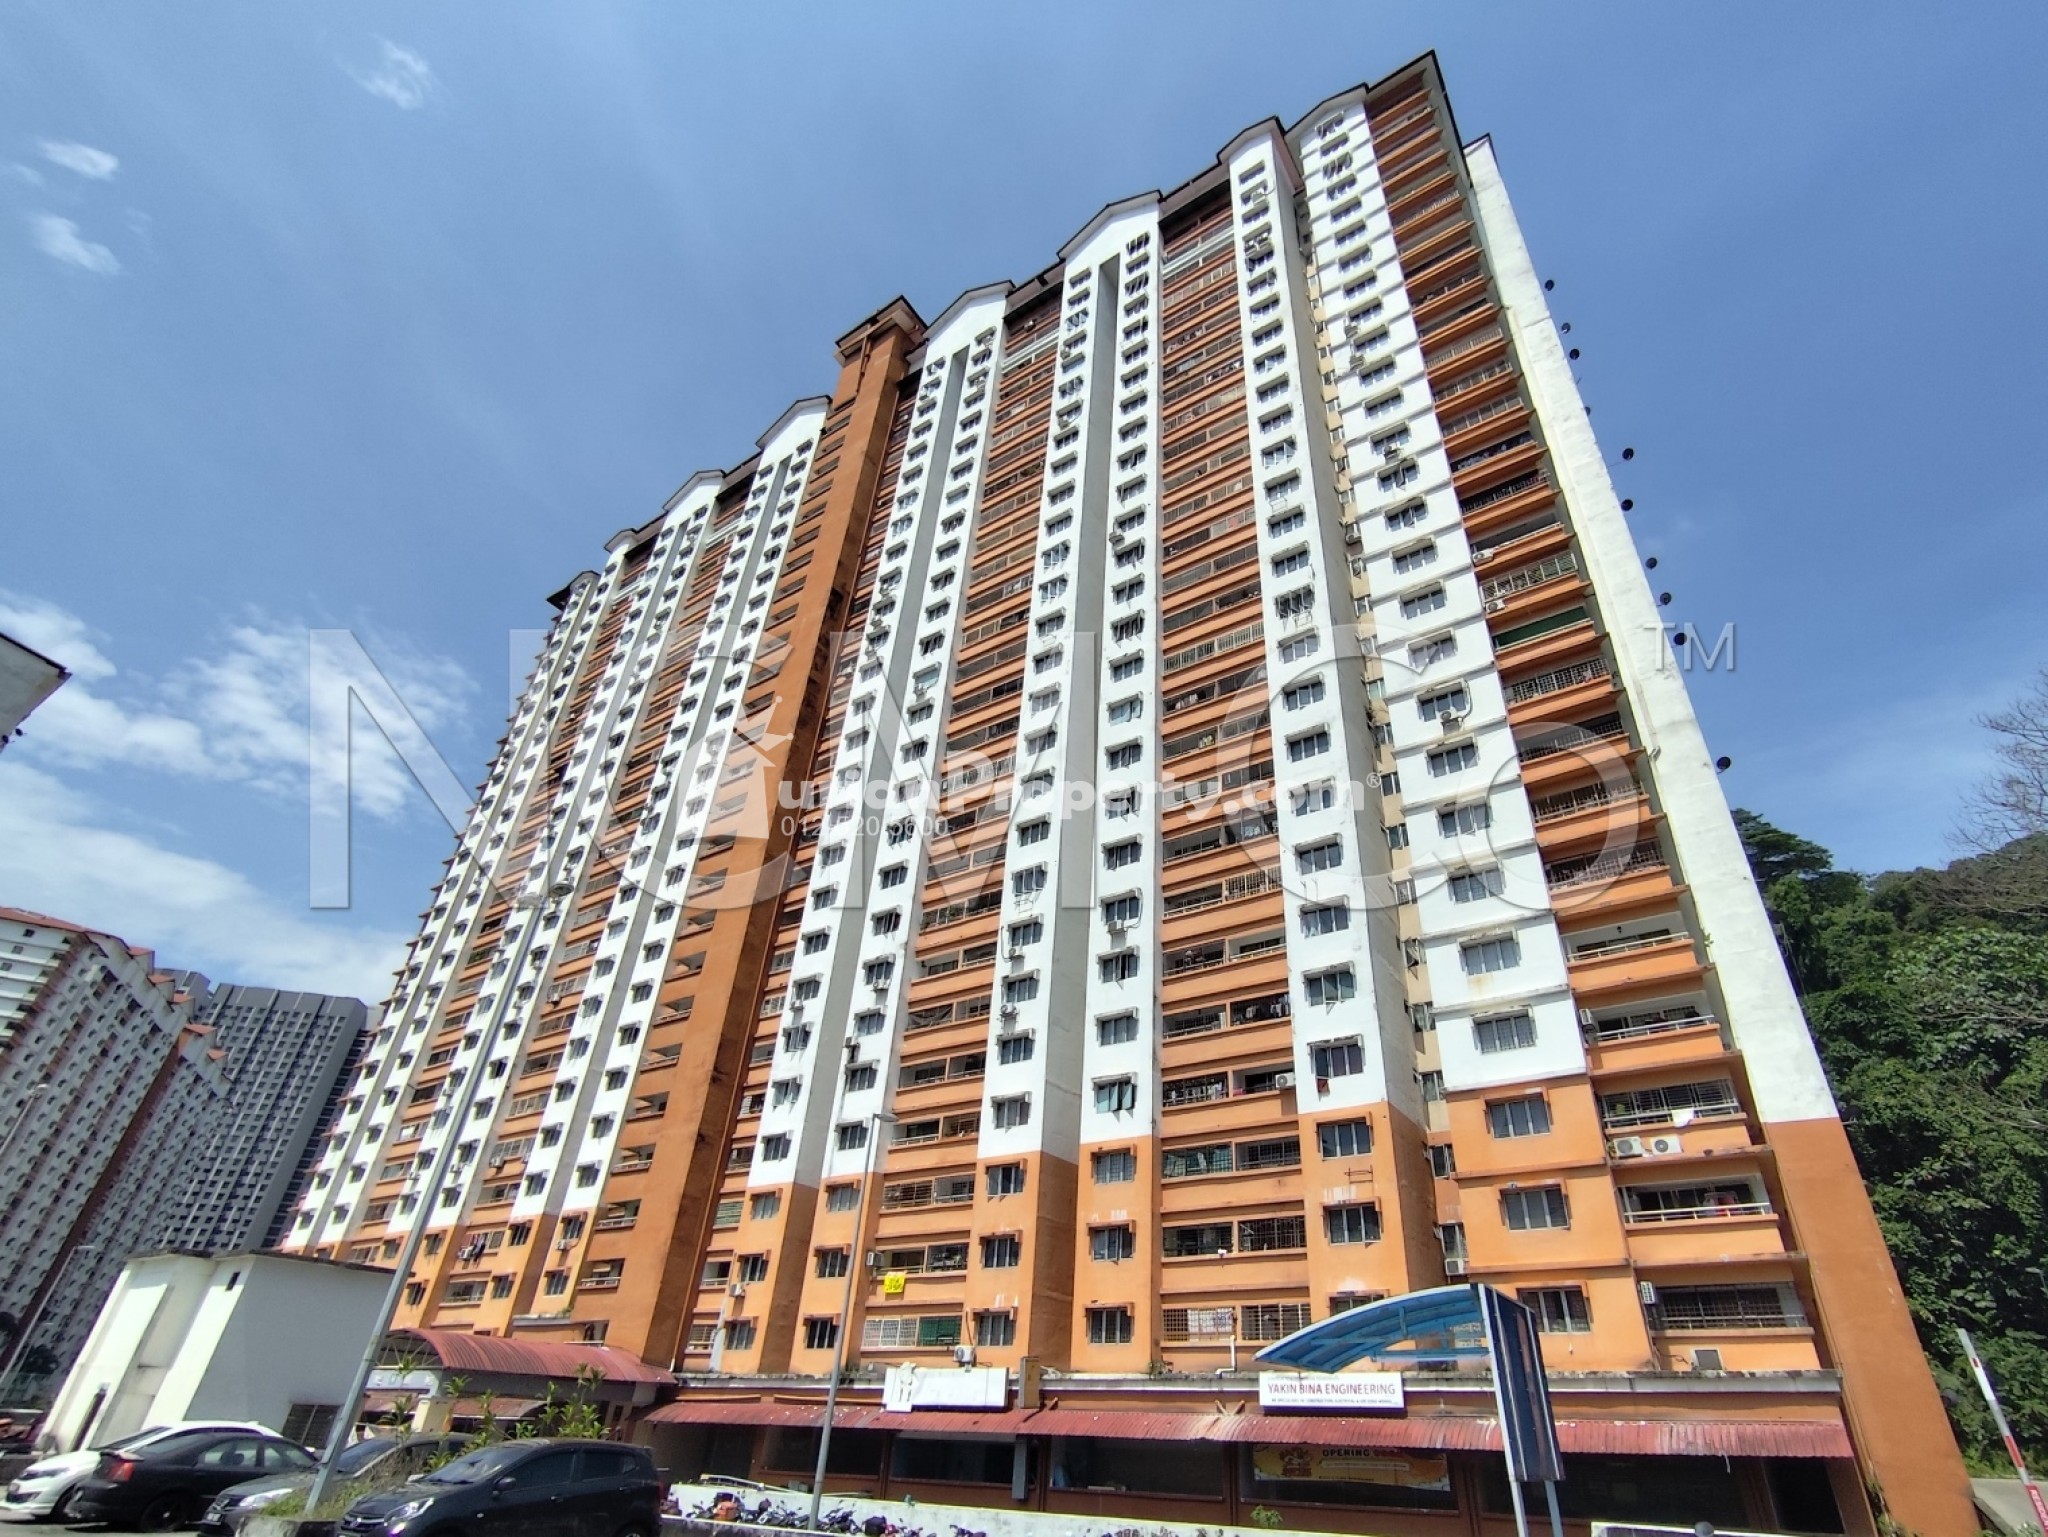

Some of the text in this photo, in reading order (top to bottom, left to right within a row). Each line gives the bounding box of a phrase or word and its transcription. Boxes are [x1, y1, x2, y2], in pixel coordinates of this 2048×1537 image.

[1267, 1383, 1396, 1395] YAKIN BINA ENGINEERING
[1322, 1448, 1370, 1456] OPENING
